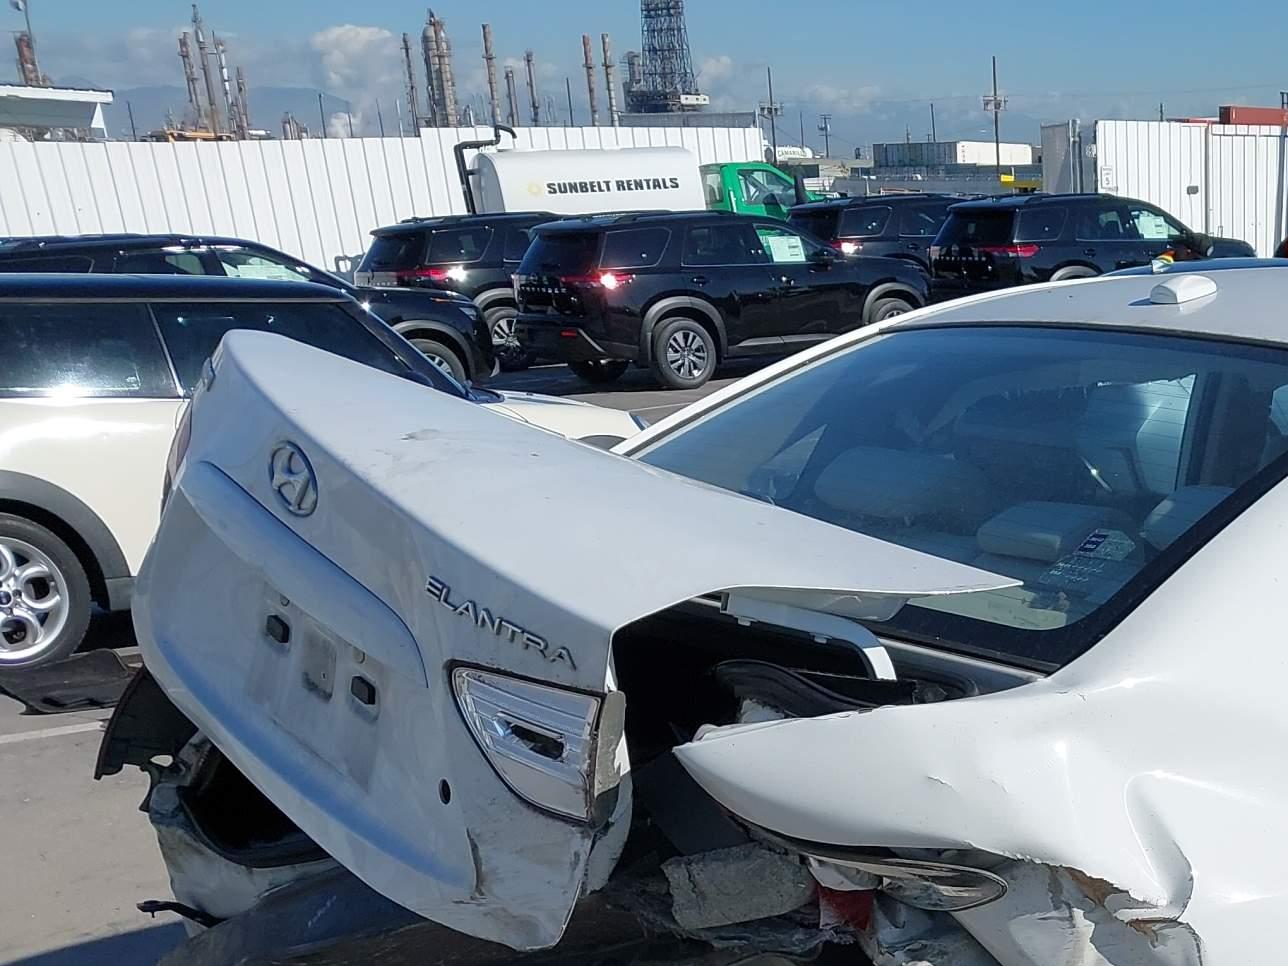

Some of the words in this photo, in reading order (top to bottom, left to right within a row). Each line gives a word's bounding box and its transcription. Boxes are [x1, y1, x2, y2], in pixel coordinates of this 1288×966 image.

[546, 180, 612, 195] SUNBELT
[616, 177, 680, 192] RENTALS
[425, 576, 577, 672] ELANTRA
